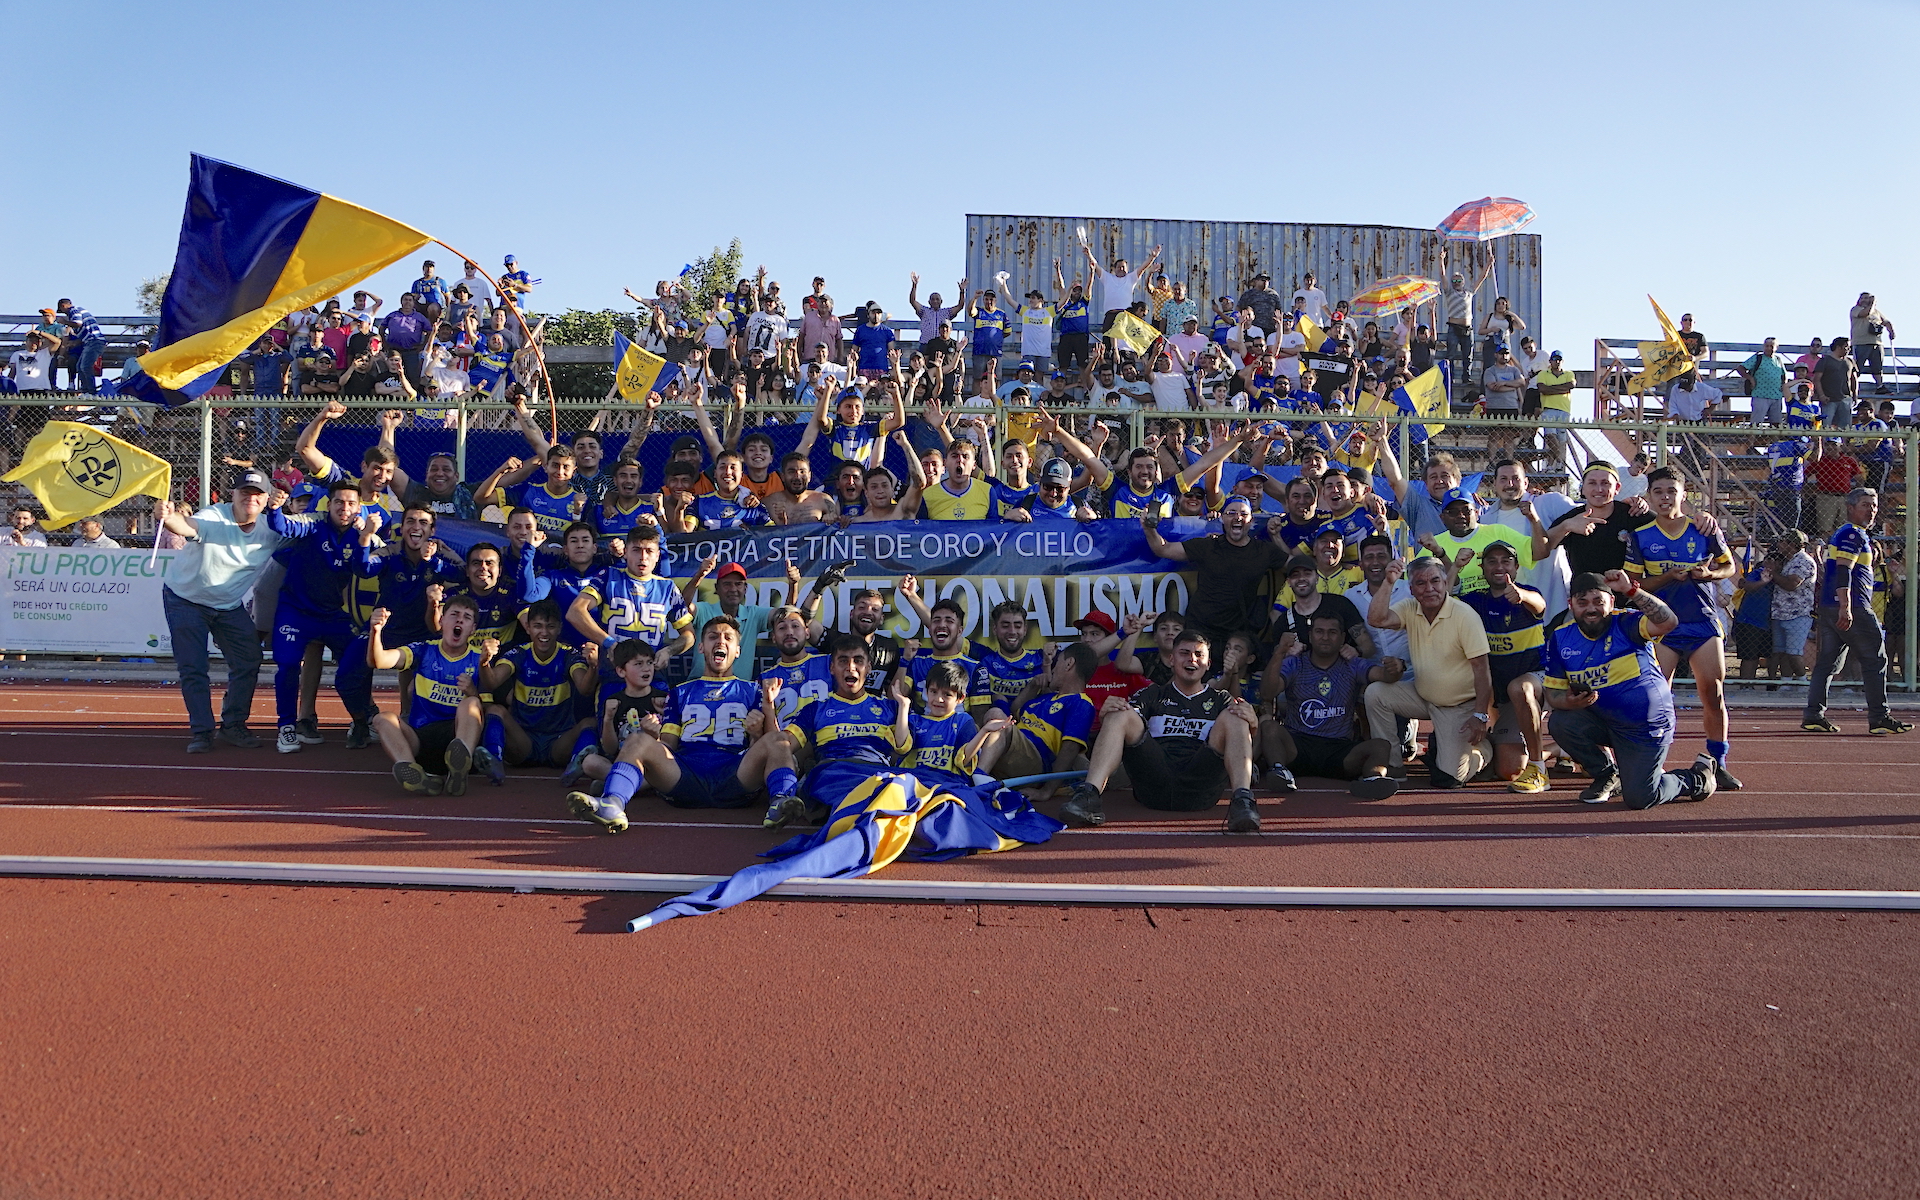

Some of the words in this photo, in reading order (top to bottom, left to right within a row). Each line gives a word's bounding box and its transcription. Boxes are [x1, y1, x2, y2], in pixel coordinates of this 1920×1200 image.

[667, 539, 759, 564] STORIA
[768, 537, 799, 562] SE
[804, 531, 867, 561] TIÑE
[875, 533, 912, 560] DE
[920, 532, 985, 558] ORO
[990, 532, 1009, 557] Y
[1015, 531, 1094, 558] CIELO
[7, 552, 49, 579] ¡TU
[54, 553, 176, 578] PROYECT
[13, 578, 45, 592] SERÁ
[50, 581, 69, 593] UN
[72, 583, 131, 595] GOLAZO!
[13, 601, 33, 610] PIDE
[35, 602, 53, 610] HOY
[56, 603, 67, 611] TU
[69, 601, 108, 612] CRÉDITO
[13, 612, 25, 620] DE
[27, 613, 72, 621] CONSUMO
[608, 597, 666, 647] 25
[680, 702, 748, 746] 26
[834, 725, 881, 734] FUNNY
[1163, 717, 1207, 730] FUNNY
[1162, 726, 1202, 739] BIKES
